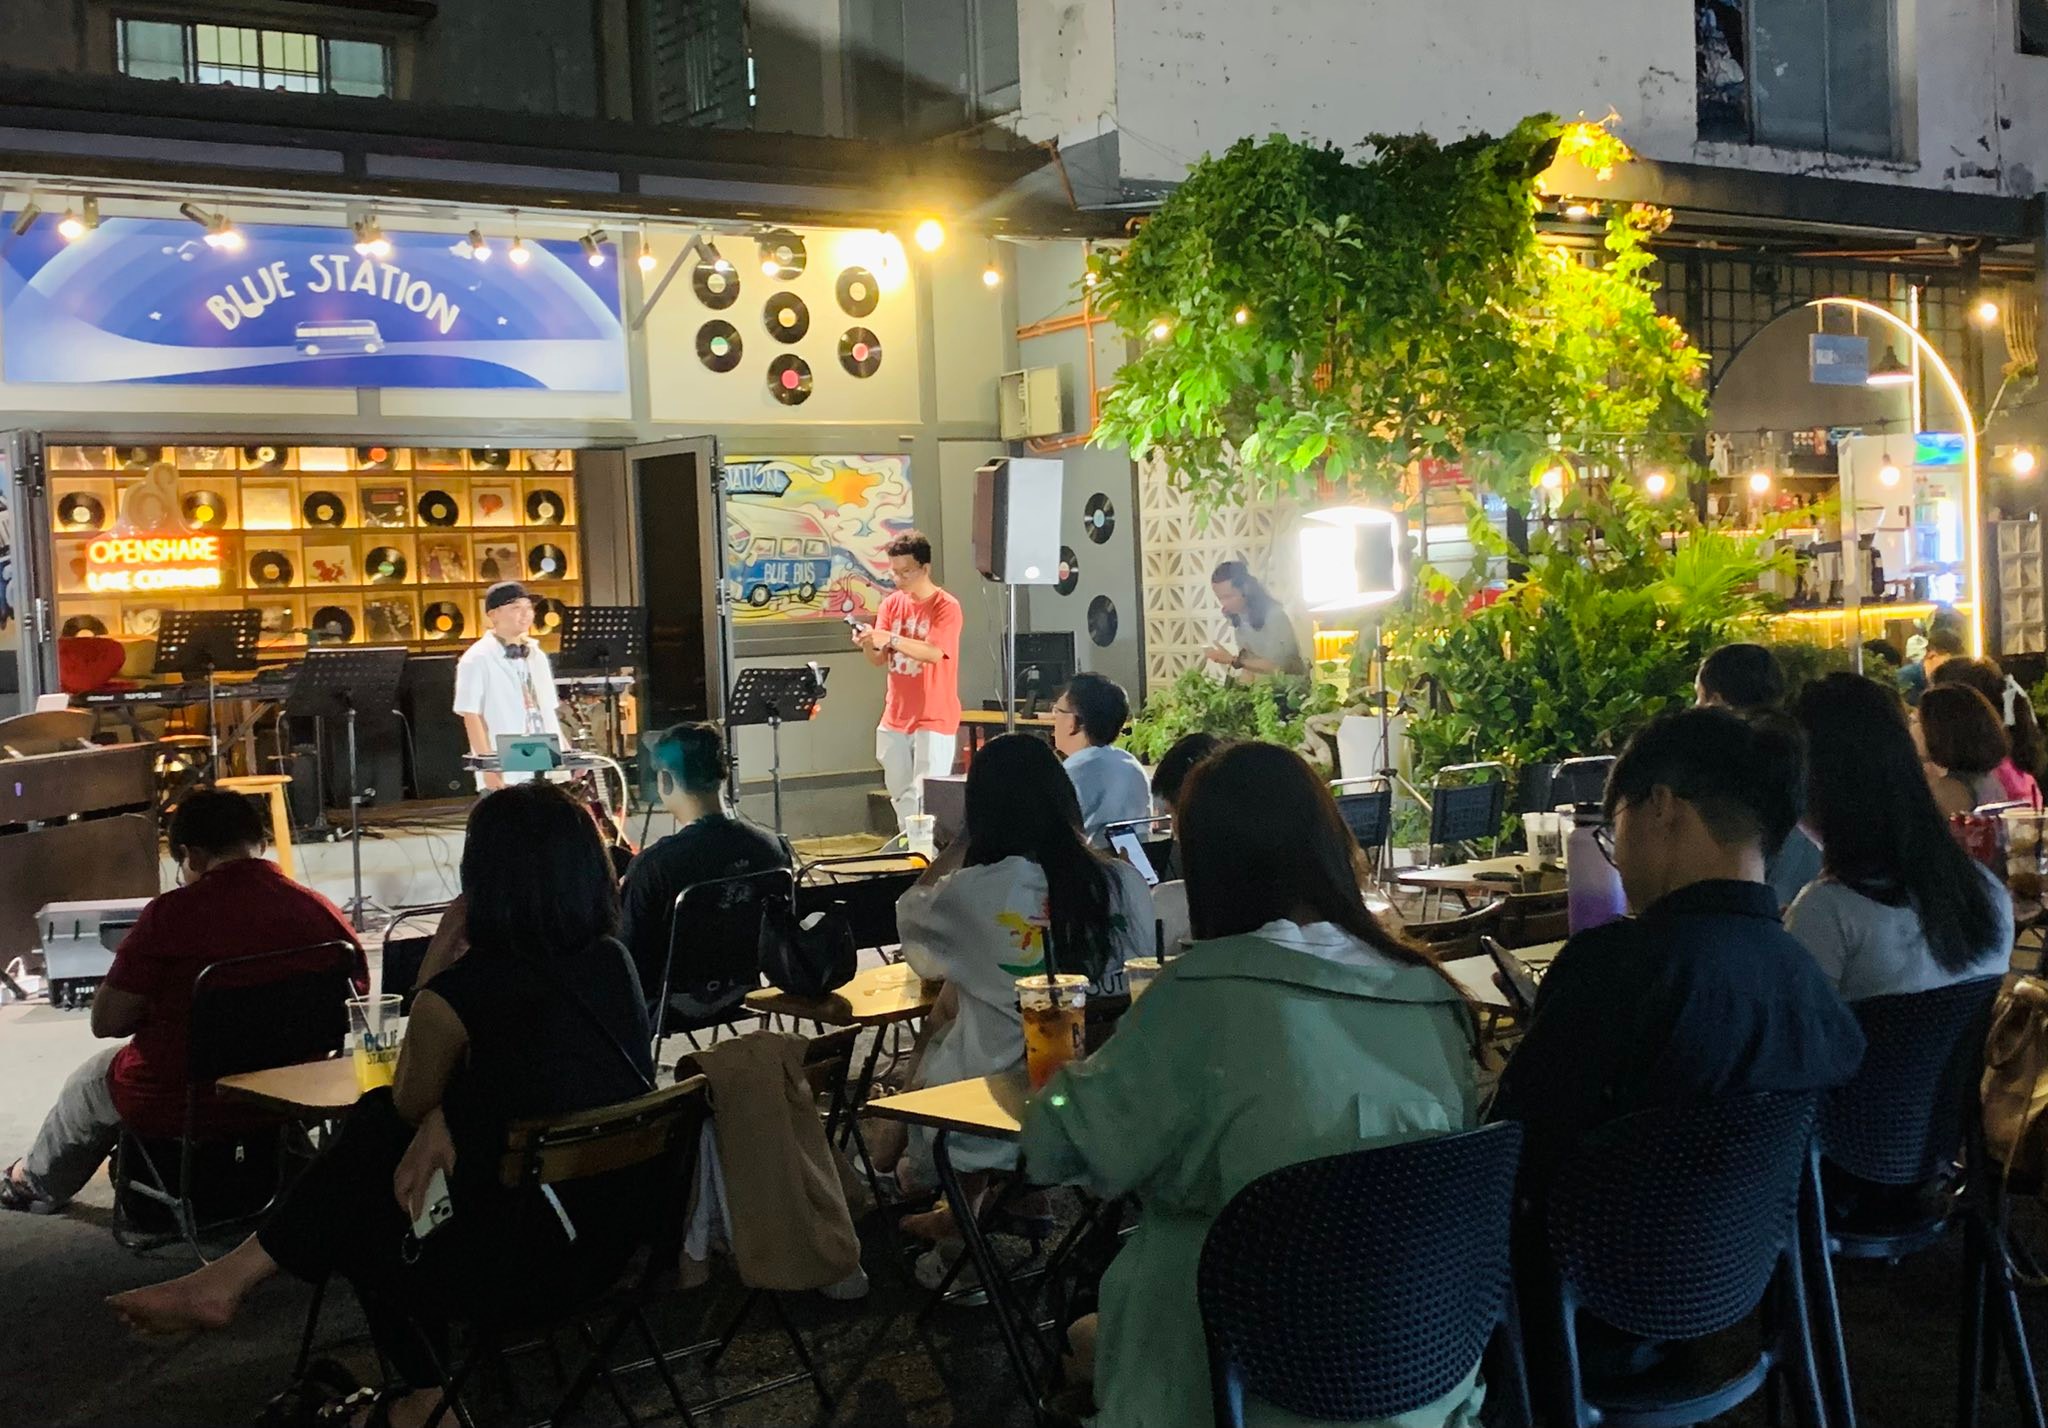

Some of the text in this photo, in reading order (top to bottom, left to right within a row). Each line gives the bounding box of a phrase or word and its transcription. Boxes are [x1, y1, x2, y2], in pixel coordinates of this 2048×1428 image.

[206, 254, 460, 334] BLUE STATION
[89, 536, 219, 564] OPENSHARE
[87, 570, 130, 592] LE
[764, 562, 815, 585] BLUE BUS
